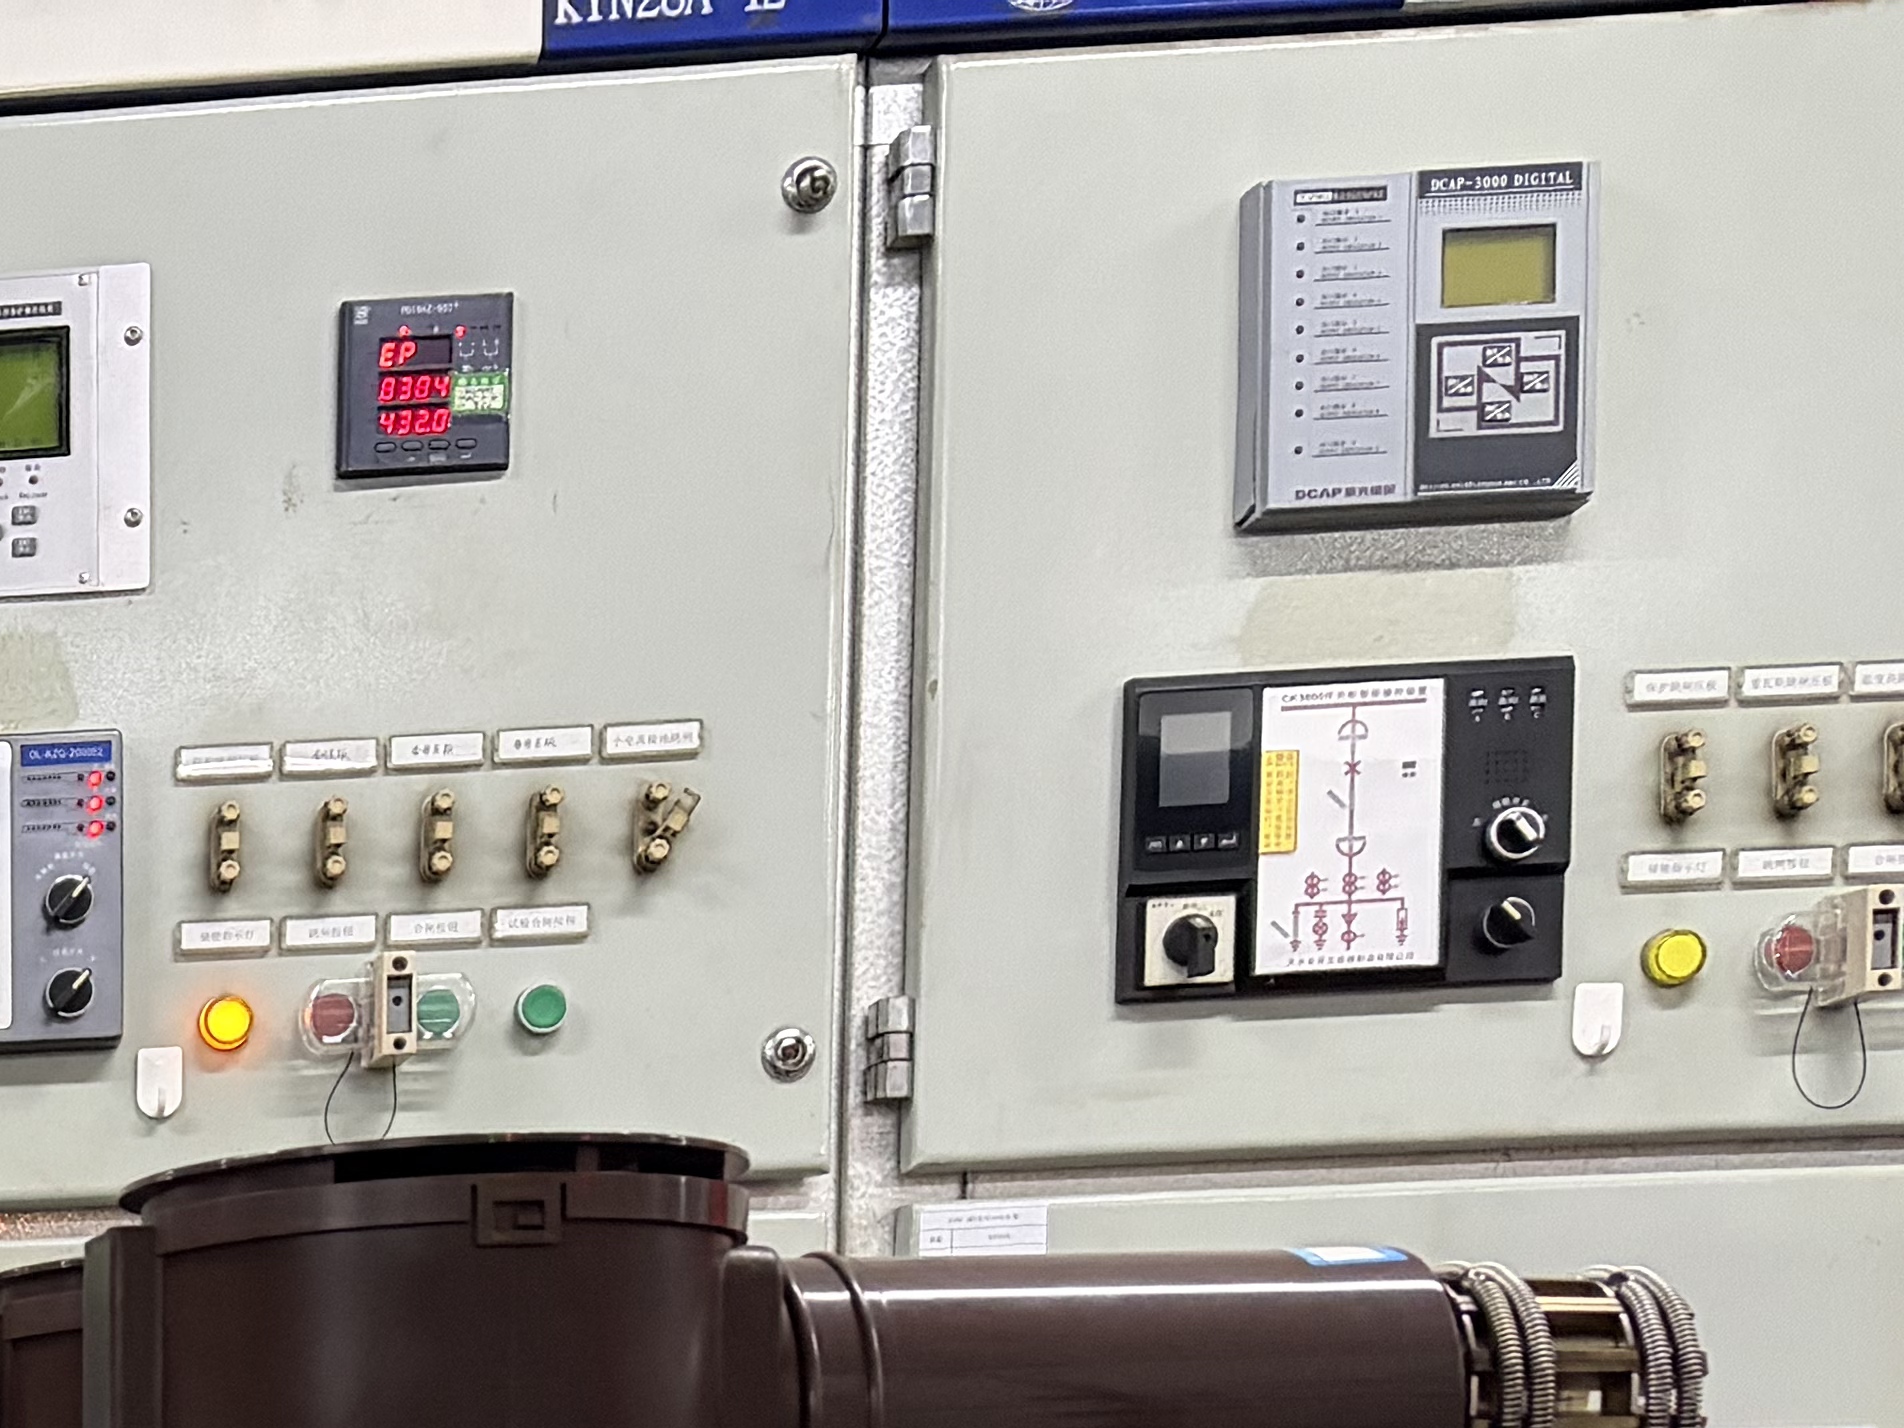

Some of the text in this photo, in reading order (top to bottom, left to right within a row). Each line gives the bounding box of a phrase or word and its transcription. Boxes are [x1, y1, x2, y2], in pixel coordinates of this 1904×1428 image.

[1430, 170, 1574, 191] DCAP-3000 DIGITAL
[378, 340, 417, 368] EP
[1295, 487, 1342, 500] DCAP
